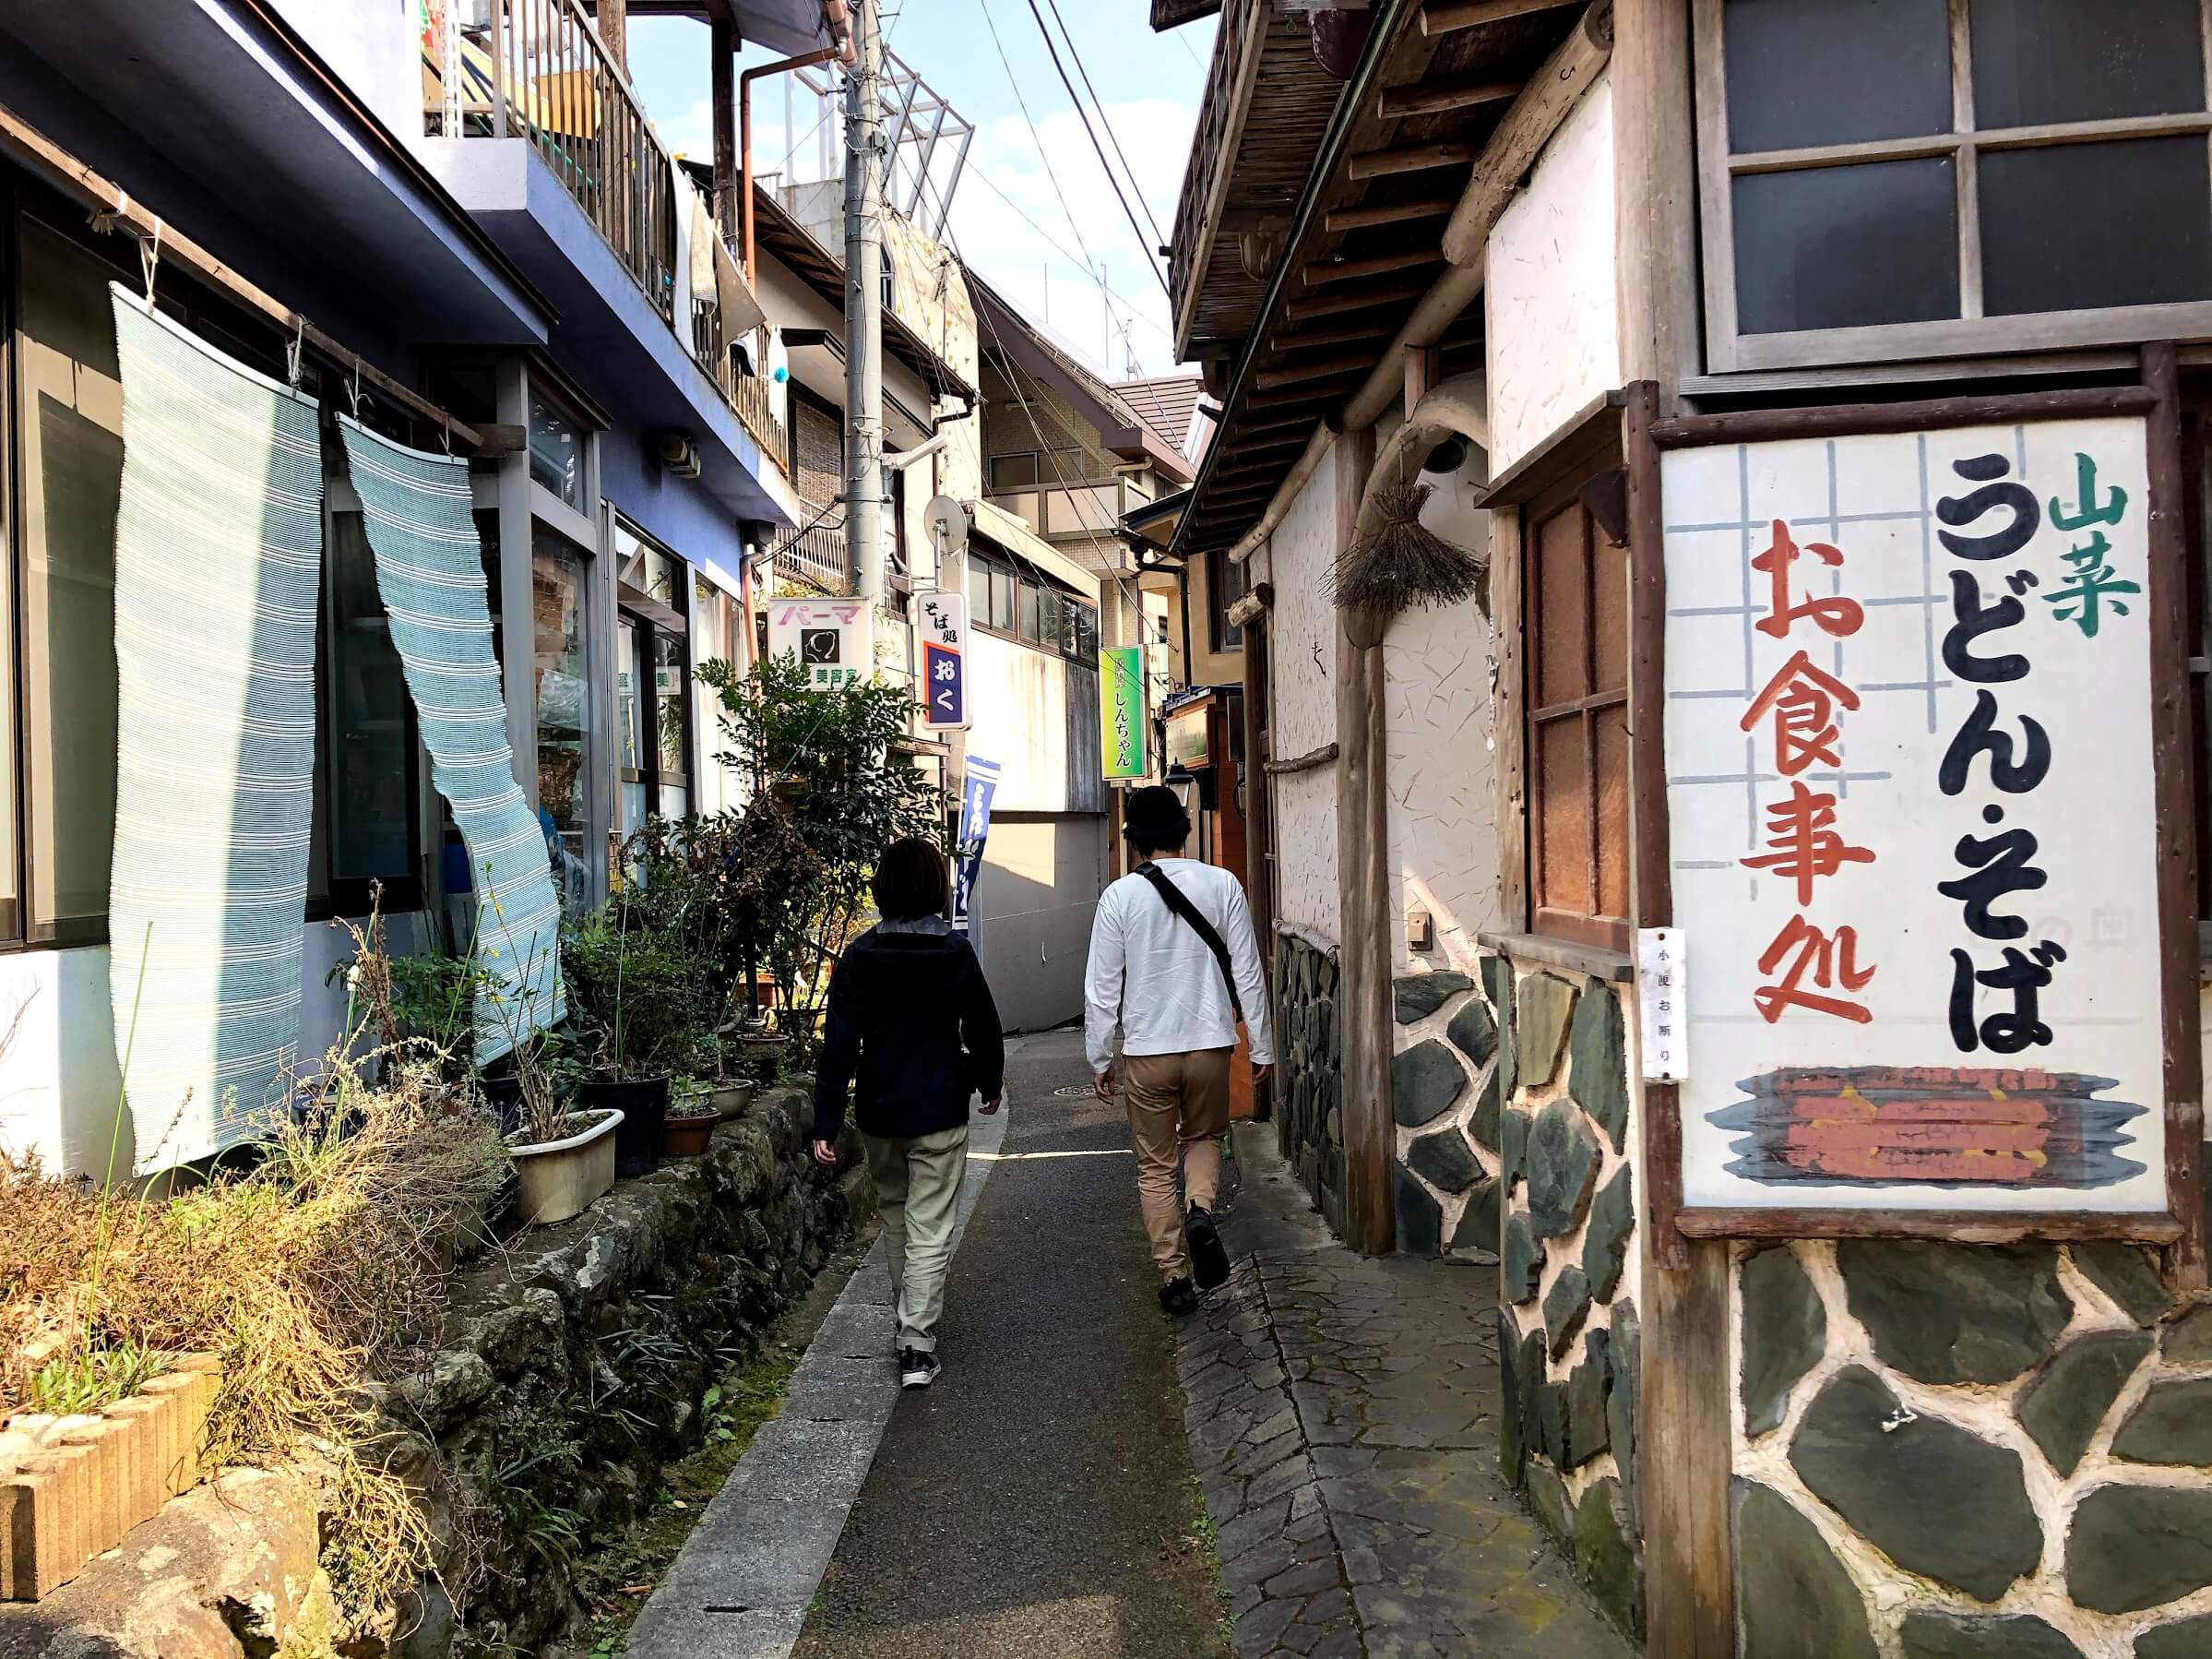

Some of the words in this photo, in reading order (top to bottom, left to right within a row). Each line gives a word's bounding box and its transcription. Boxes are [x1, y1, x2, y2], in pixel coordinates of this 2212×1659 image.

[2042, 451, 2141, 638] 山菜
[778, 605, 862, 626] パーマ
[924, 602, 957, 643] そば処
[934, 659, 956, 711] おく
[1114, 692, 1132, 767] しんちゃん
[1739, 518, 1876, 1025] お食事処
[1937, 452, 2066, 1054] うどん・そば
[1658, 949, 1671, 1062] 小便お断り
